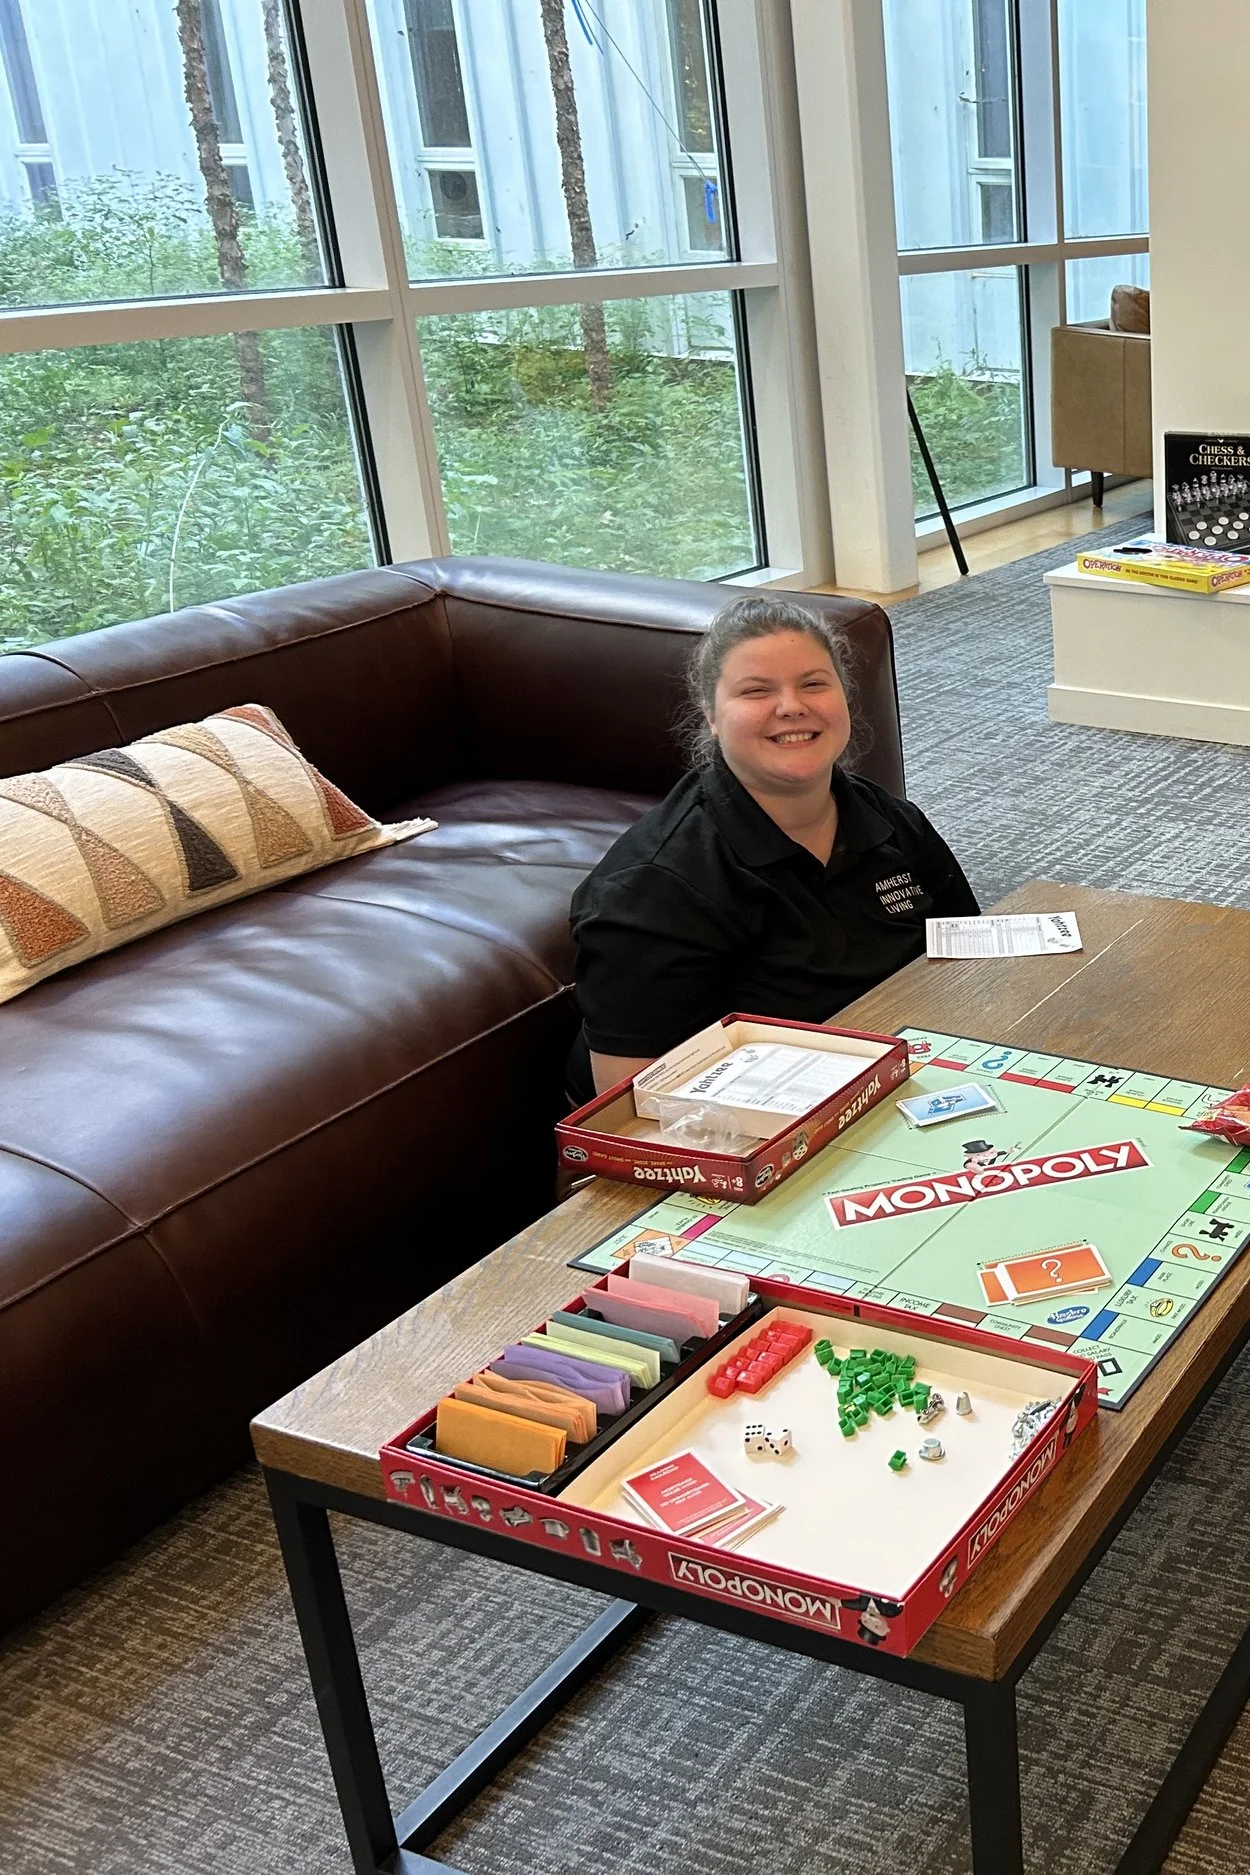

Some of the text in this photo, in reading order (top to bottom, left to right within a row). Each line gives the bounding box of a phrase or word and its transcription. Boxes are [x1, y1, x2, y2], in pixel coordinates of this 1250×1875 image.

[1199, 444, 1245, 455] CHESS &
[1083, 558, 1122, 573] OPERATION
[875, 872, 912, 893] AMHERST
[880, 885, 924, 905] INNOVATIVE
[886, 900, 914, 914] LIVING
[689, 1062, 734, 1094] Yahtzee
[839, 1074, 881, 1130] Yahtzee
[633, 1164, 706, 1184] Yahtzee
[843, 1144, 1132, 1221] MONOPOLY
[900, 1297, 931, 1309] INCOME
[1126, 1295, 1138, 1305] TAX
[904, 1304, 918, 1312] TAX
[989, 1318, 1022, 1330] COMMUNITY
[994, 1324, 1012, 1332] CHEST
[1073, 1344, 1100, 1354] COLLECT
[1088, 1348, 1110, 1357] SALARY
[970, 1438, 1056, 1561] MONOPOLY
[678, 1560, 832, 1622] MONOPOLY
